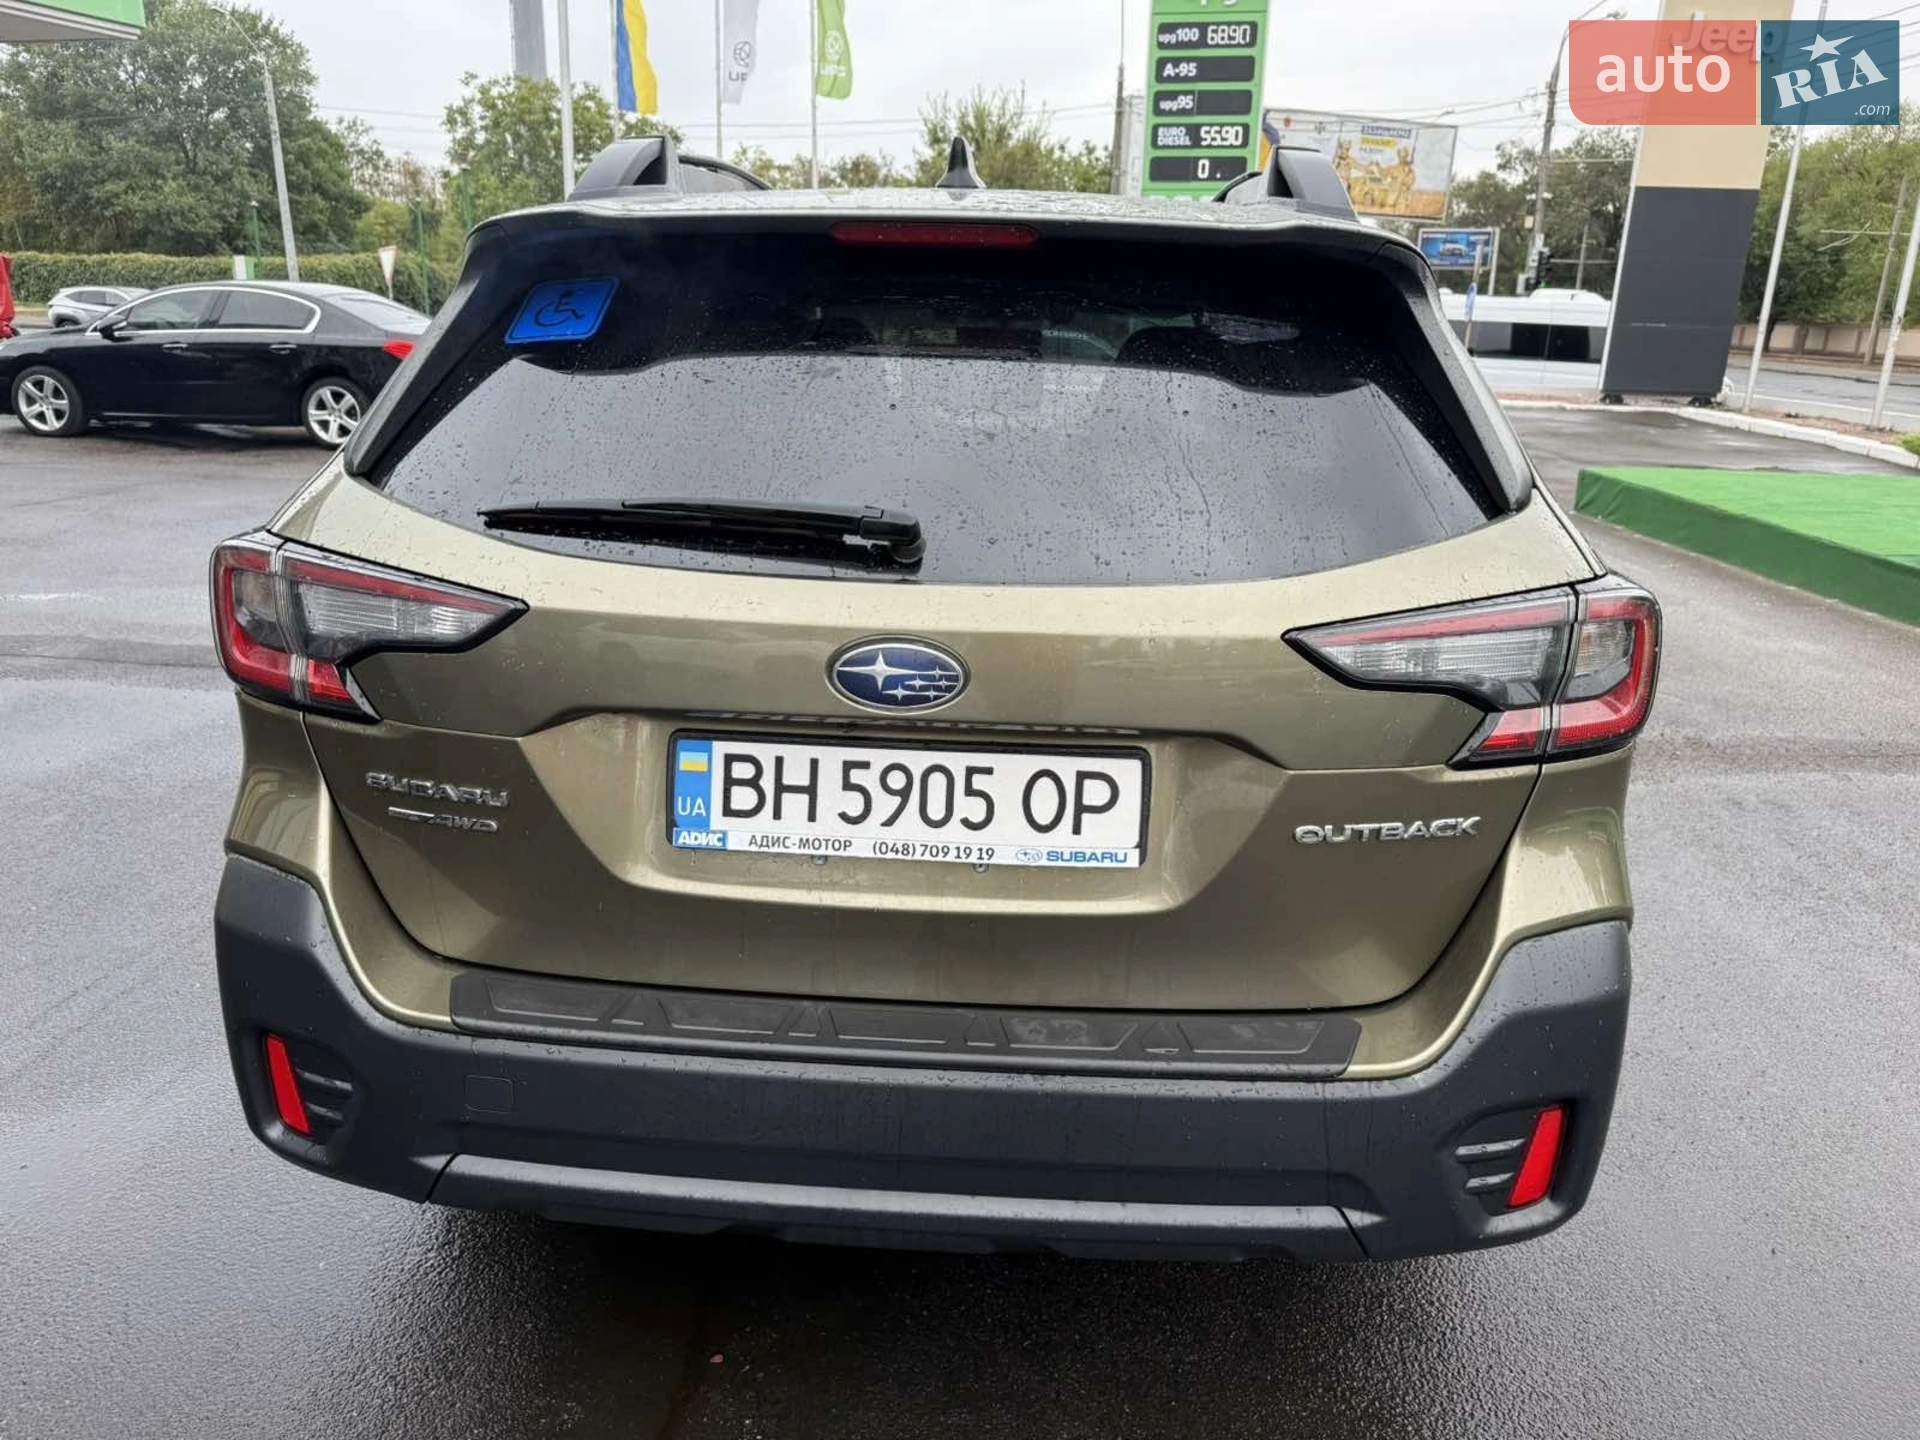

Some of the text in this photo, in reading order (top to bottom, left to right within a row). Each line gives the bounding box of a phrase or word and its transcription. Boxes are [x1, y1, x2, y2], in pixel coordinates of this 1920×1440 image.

[1163, 62, 1198, 78] A-95
[1158, 126, 1187, 137] EURO
[1157, 136, 1192, 146] DIESEL
[365, 771, 509, 807] SUBARU
[722, 753, 1121, 836] BH 5905 OP
[677, 800, 706, 818] UA
[1294, 816, 1481, 845] OUTBACK
[748, 834, 853, 852] АДИС-МОТОР
[872, 841, 916, 858] (048)
[920, 843, 950, 859] 709
[1046, 850, 1128, 864] SUBARU
